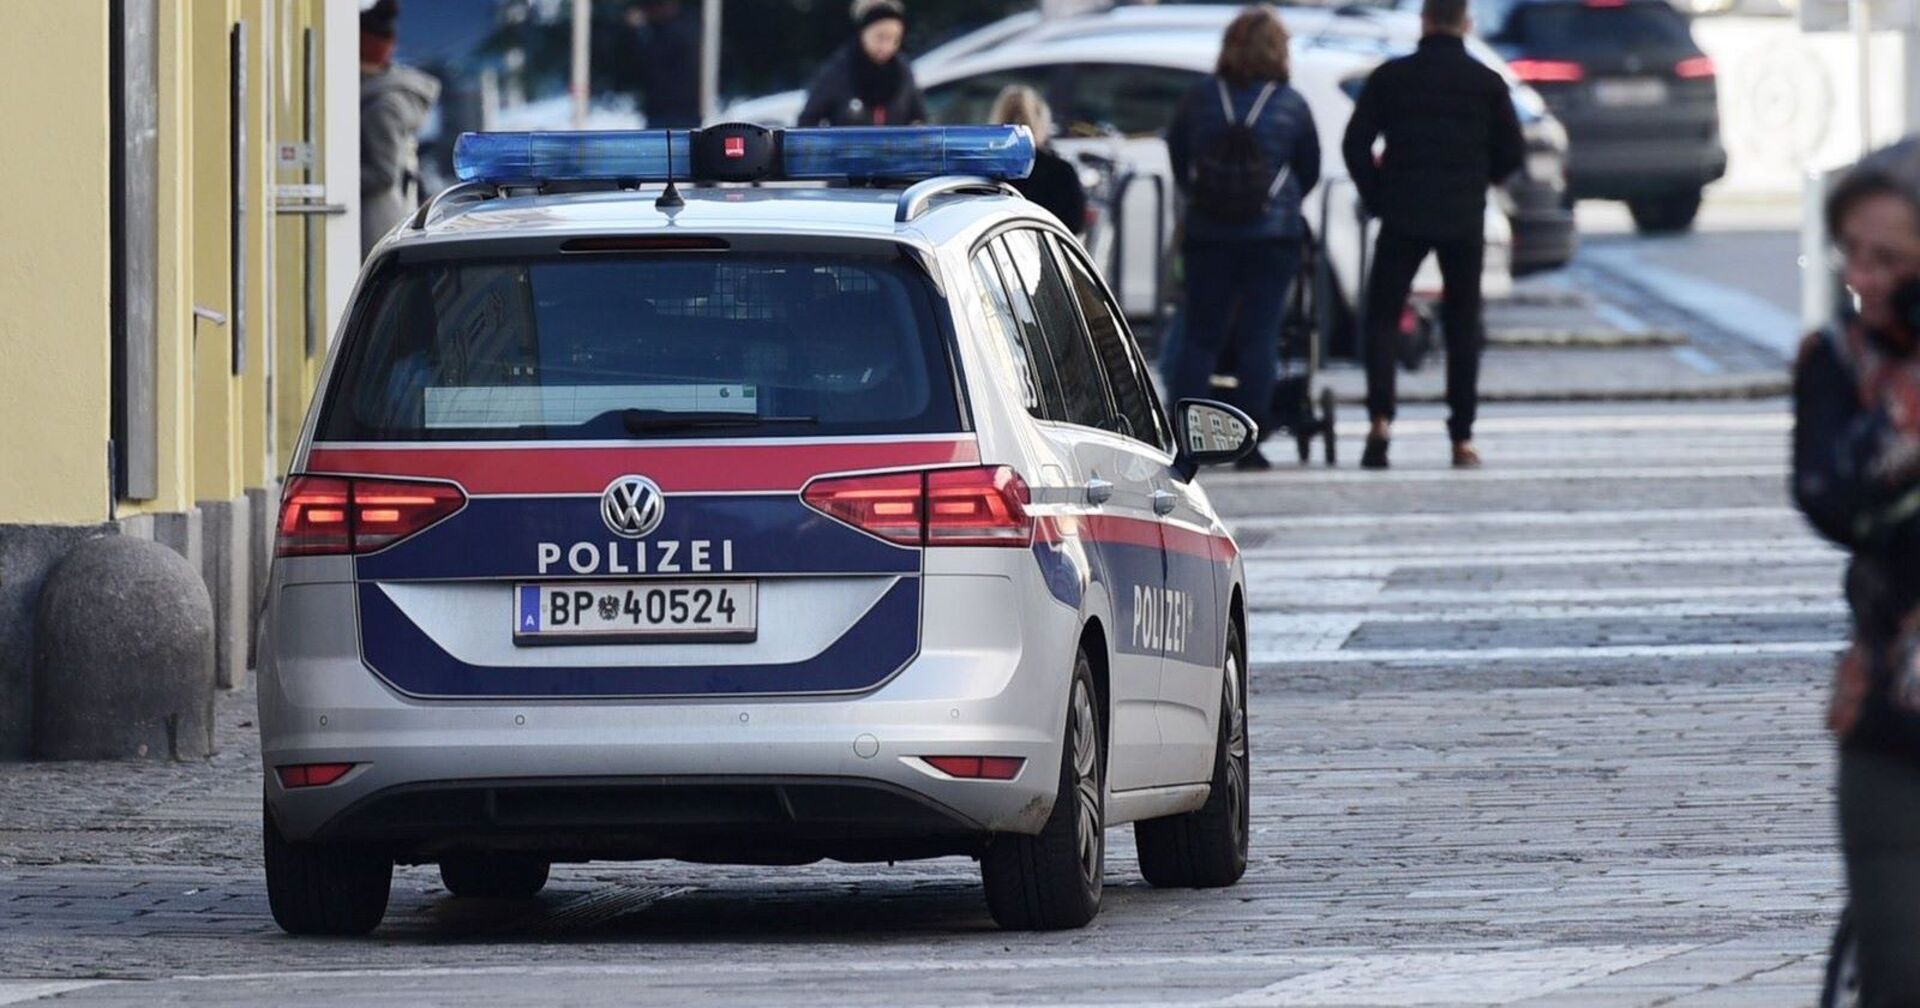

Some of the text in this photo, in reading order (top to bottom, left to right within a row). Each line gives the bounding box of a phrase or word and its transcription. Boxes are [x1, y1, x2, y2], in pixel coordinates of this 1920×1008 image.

[538, 540, 733, 574] POLIZEI
[525, 614, 535, 627] A
[550, 588, 736, 626] BP 40524
[1132, 584, 1186, 653] POLIZEI
